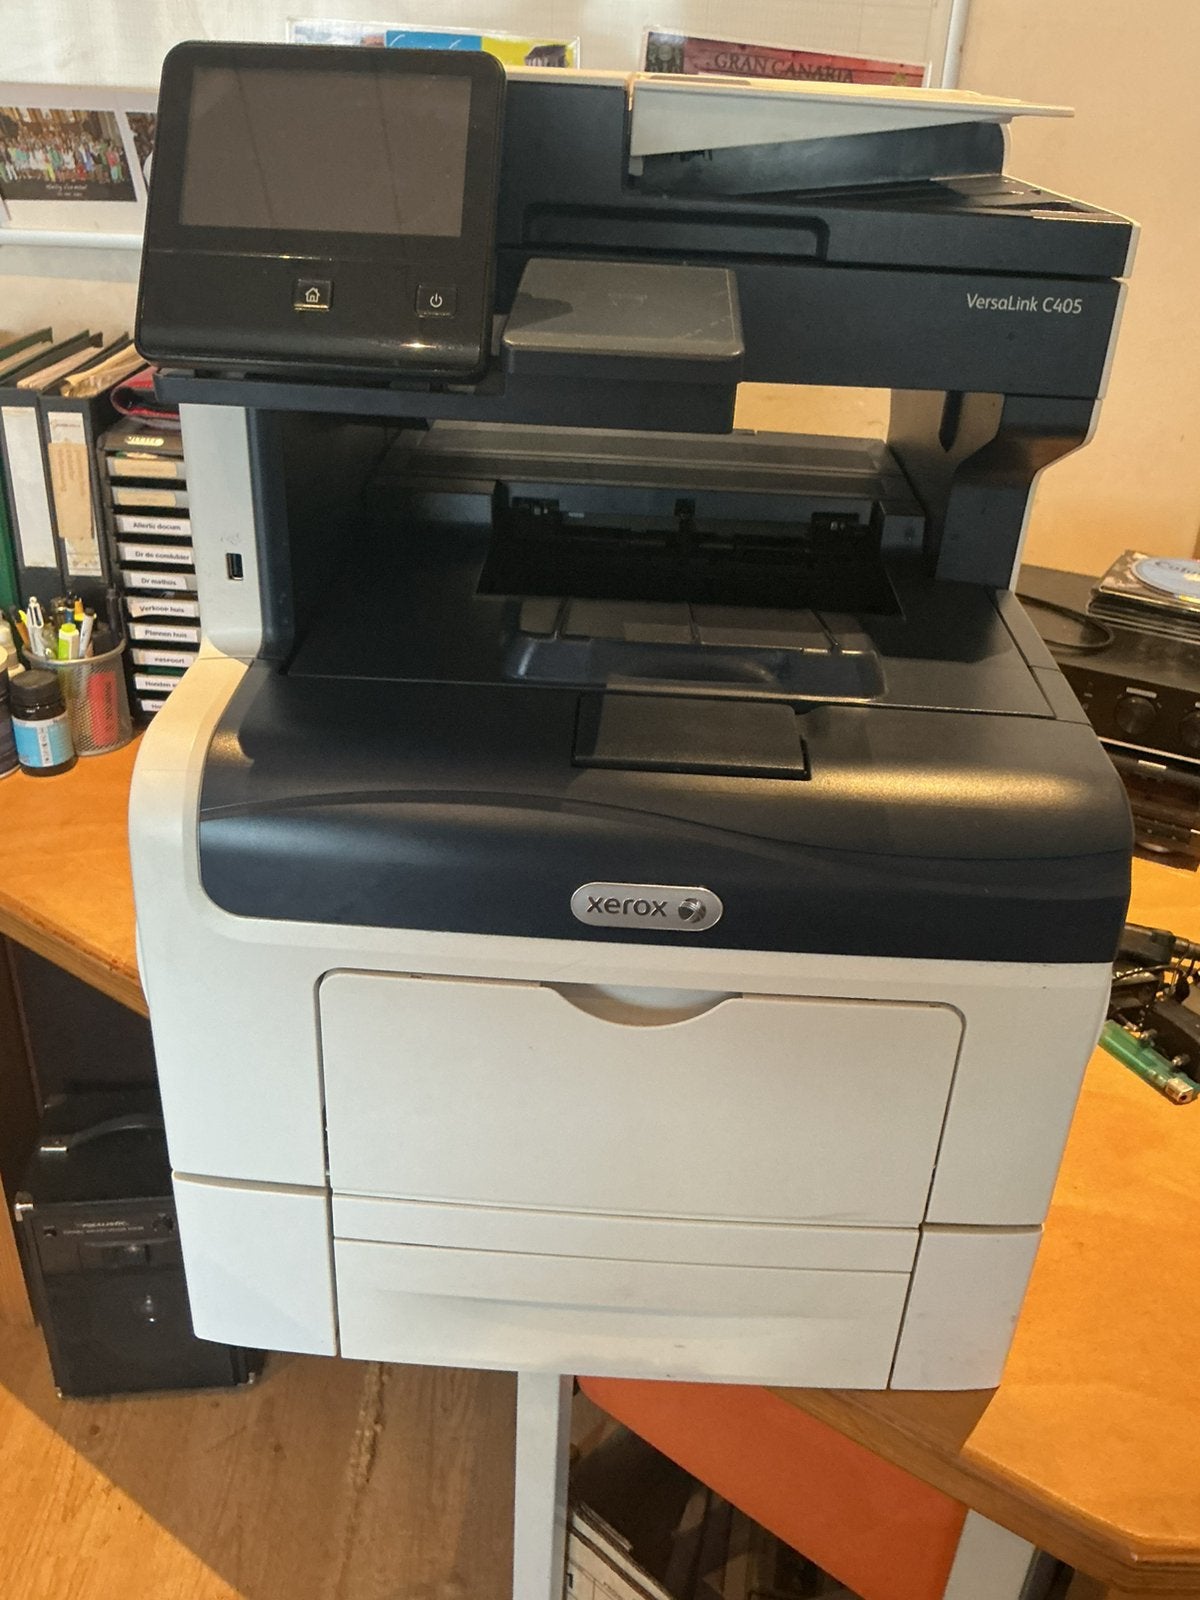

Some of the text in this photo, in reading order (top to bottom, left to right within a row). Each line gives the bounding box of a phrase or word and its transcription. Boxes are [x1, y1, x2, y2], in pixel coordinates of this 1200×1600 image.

[714, 52, 854, 83] GRAN CANARIA
[967, 293, 1082, 314] VersaLink C405
[586, 895, 668, 917] xerox
